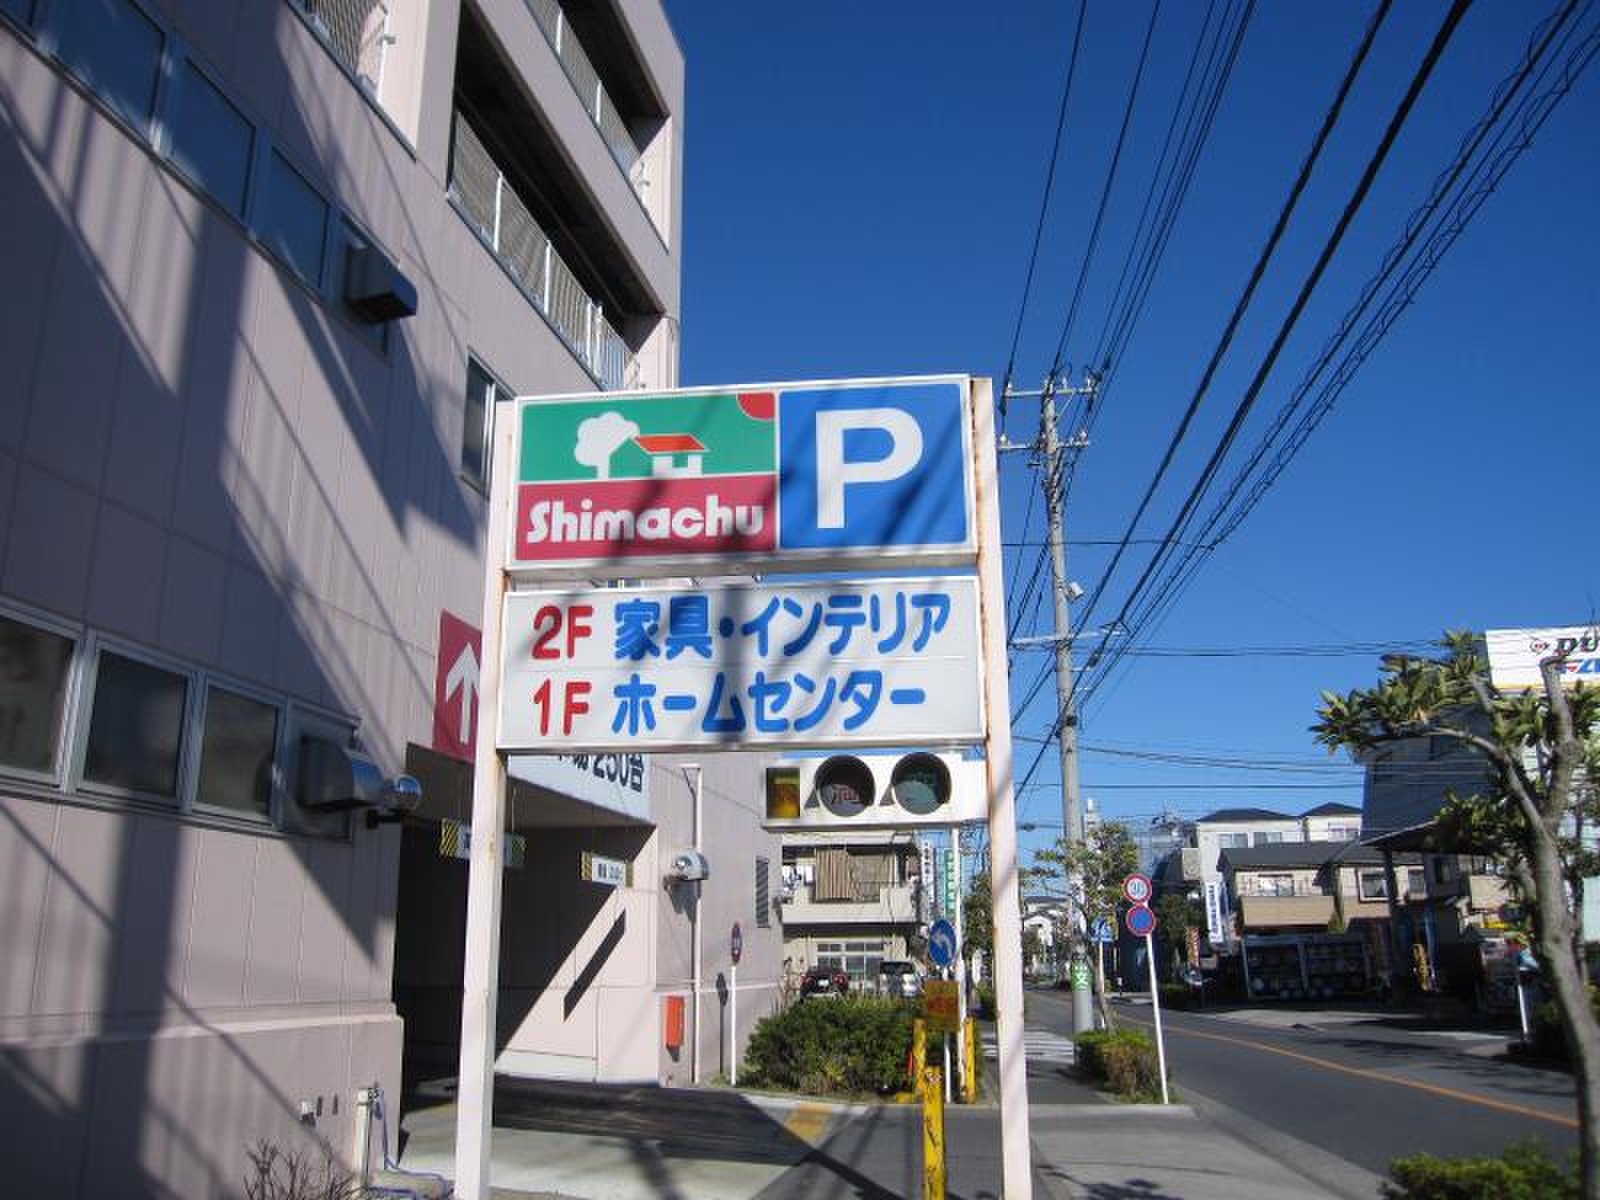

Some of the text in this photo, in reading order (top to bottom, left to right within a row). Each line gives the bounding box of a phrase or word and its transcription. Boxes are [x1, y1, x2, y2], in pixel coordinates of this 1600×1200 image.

[816, 408, 923, 529] P
[527, 493, 765, 544] Shimachu
[532, 591, 950, 660] 2F 家具・インテリア
[532, 672, 925, 736] 1F ホームセンター
